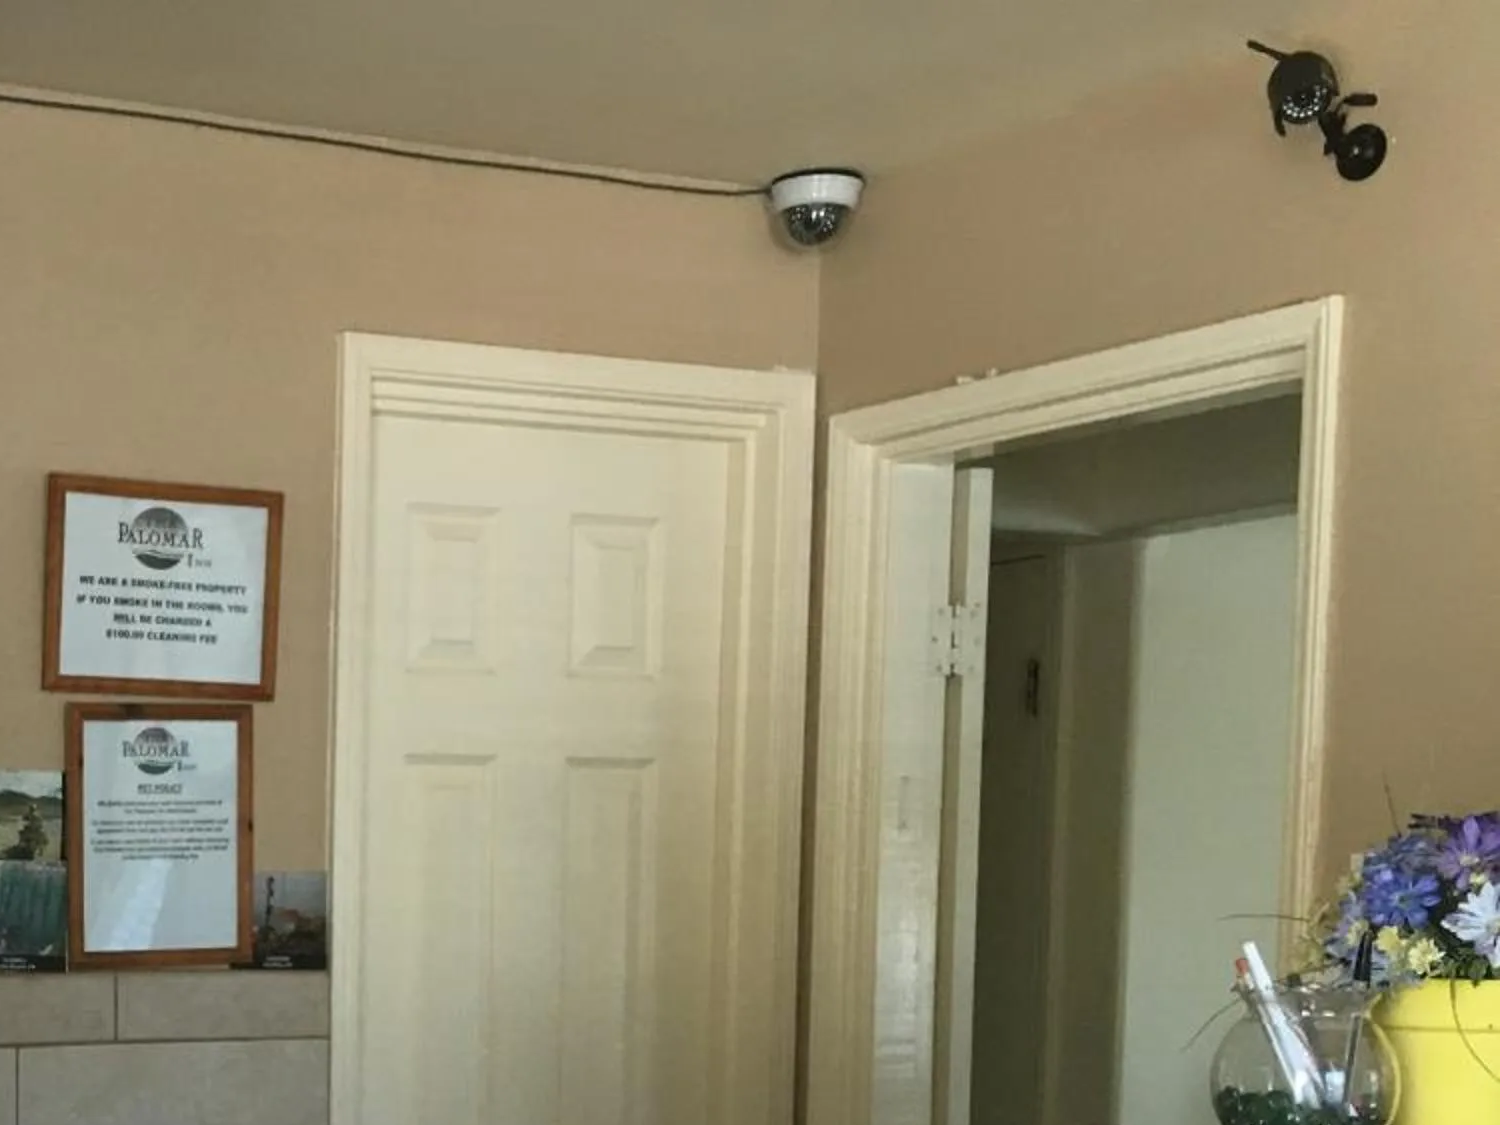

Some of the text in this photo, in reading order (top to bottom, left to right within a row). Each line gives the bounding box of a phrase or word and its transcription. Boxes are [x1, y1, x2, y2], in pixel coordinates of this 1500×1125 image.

[117, 521, 204, 550] PALOMAR
[79, 575, 95, 585] WE
[98, 576, 118, 586] ARE
[195, 582, 248, 596] PROPERTY
[76, 594, 87, 603] IF
[89, 595, 111, 605] YOU
[113, 596, 149, 608] SMOKE
[151, 600, 163, 609] IN
[165, 600, 185, 610] THE
[227, 604, 249, 614] YOU
[113, 613, 136, 624] WILL
[139, 615, 153, 625] BE
[155, 615, 203, 627] CHARGED
[147, 631, 197, 643] CLEANING
[199, 634, 218, 645] FEE
